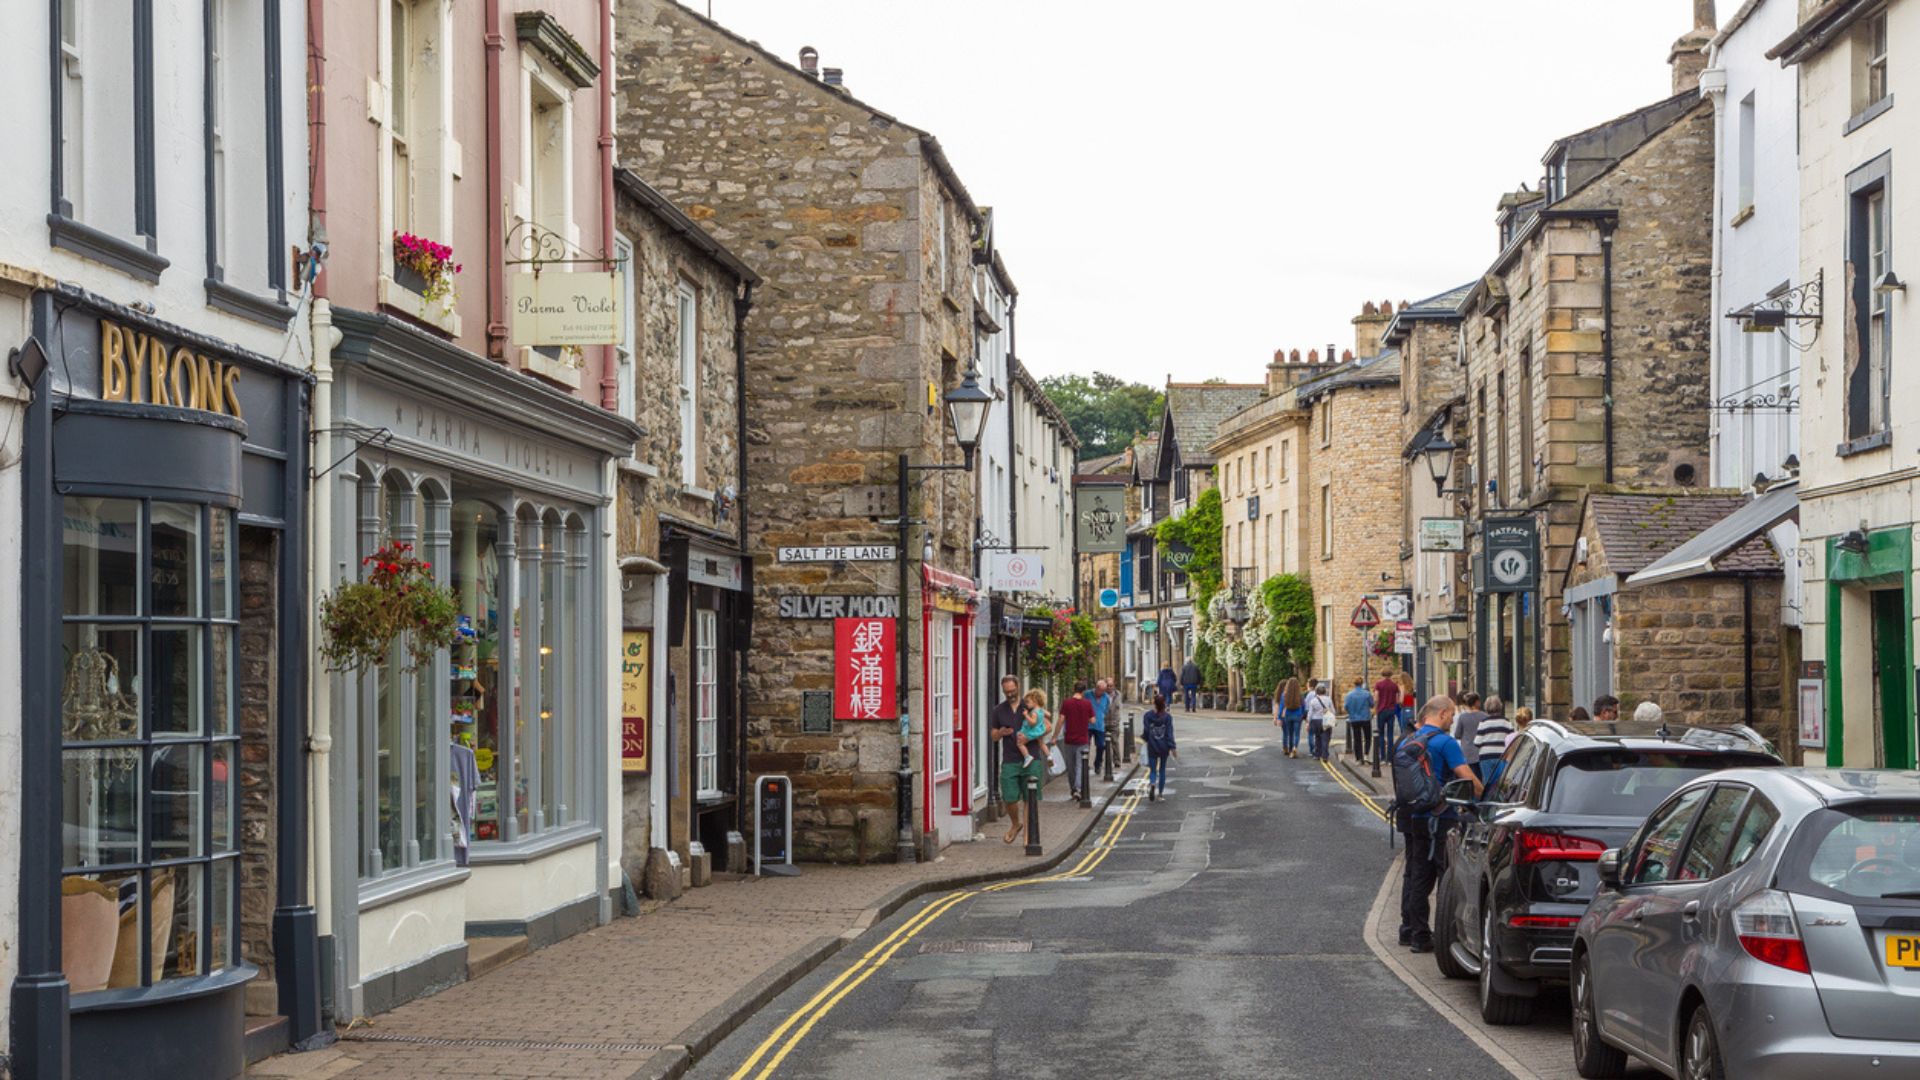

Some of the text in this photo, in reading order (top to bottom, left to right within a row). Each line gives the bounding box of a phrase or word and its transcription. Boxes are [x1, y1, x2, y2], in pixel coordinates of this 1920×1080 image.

[518, 295, 617, 314] Parma Violet
[101, 319, 241, 418] BYRONS
[416, 405, 560, 478] PARMA VIOLET
[1490, 526, 1529, 538] FATFACE
[785, 547, 890, 560] SALT PIE LANE
[997, 579, 1037, 588] SIENNA
[780, 596, 900, 618] SILVER MOON
[628, 642, 642, 657] &
